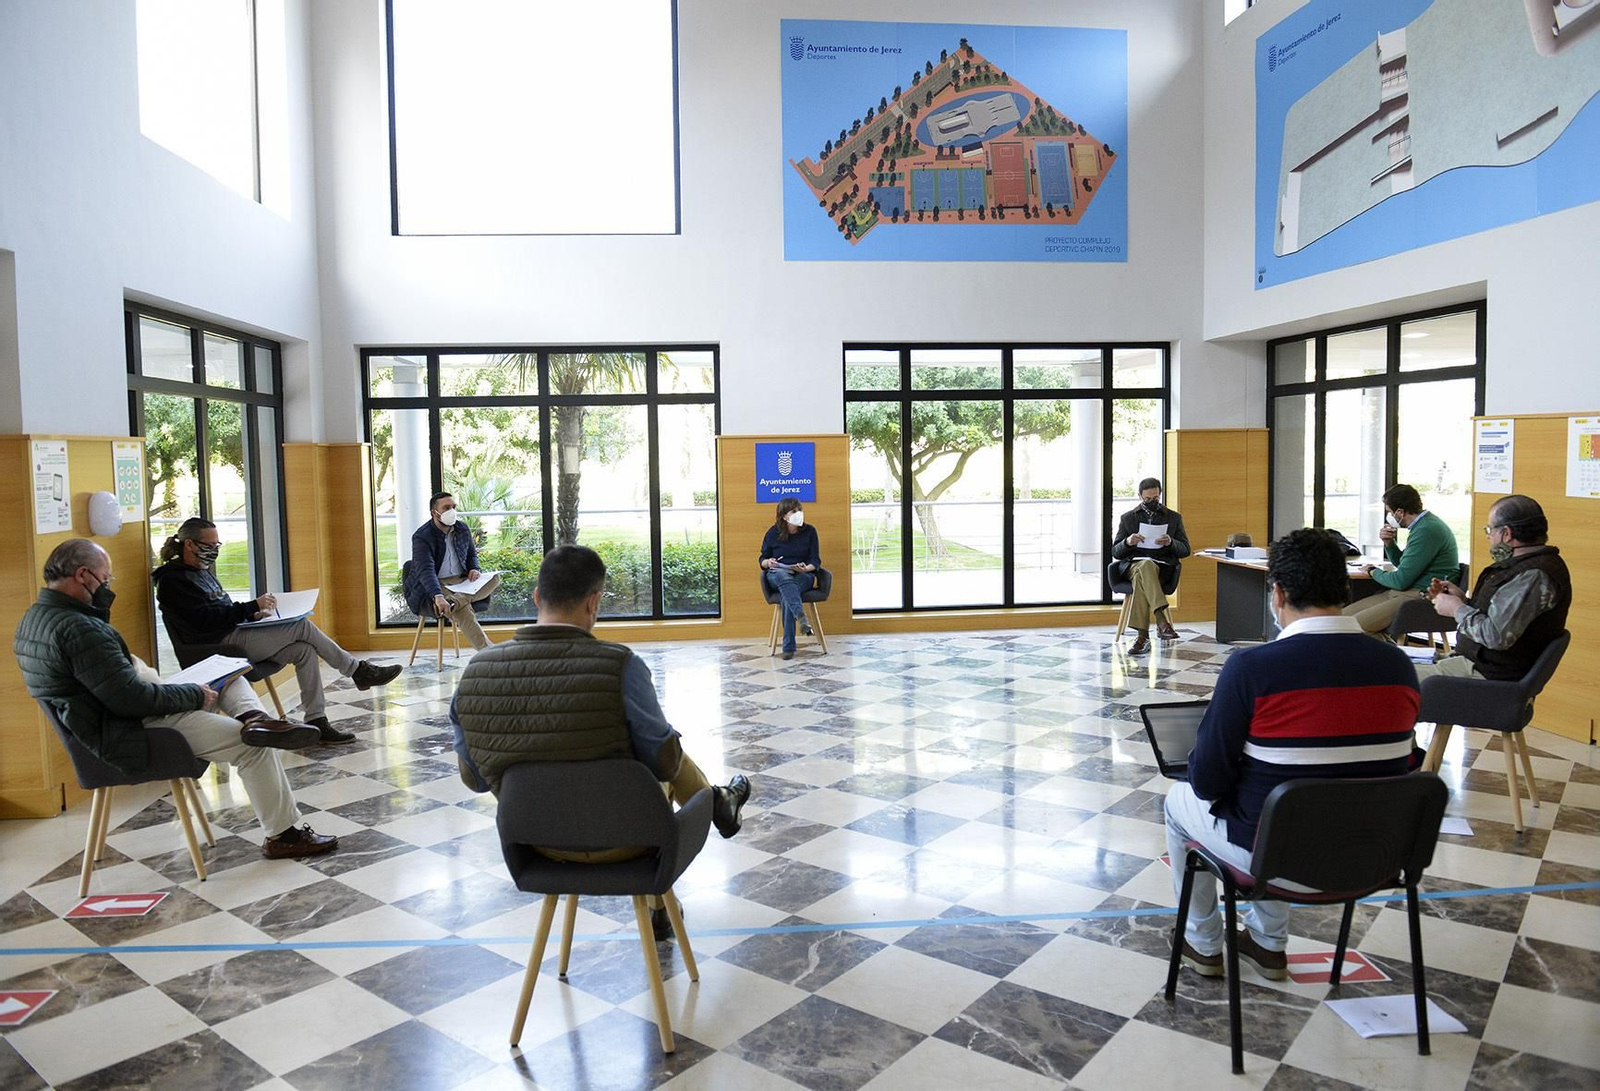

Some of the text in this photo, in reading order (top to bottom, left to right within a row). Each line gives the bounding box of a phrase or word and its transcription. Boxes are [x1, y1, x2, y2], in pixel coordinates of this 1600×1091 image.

[1317, 23, 1325, 33] de
[807, 44, 902, 55] Ayuntamiento de Jerez
[807, 53, 836, 61] Deportes
[1045, 236, 1111, 245] PROYECTO COMPLEJO
[1045, 245, 1079, 253] DEPORTIVO
[1104, 245, 1121, 253] 2019
[760, 477, 812, 487] Ayuntamiento
[770, 486, 801, 495] de Jerez
